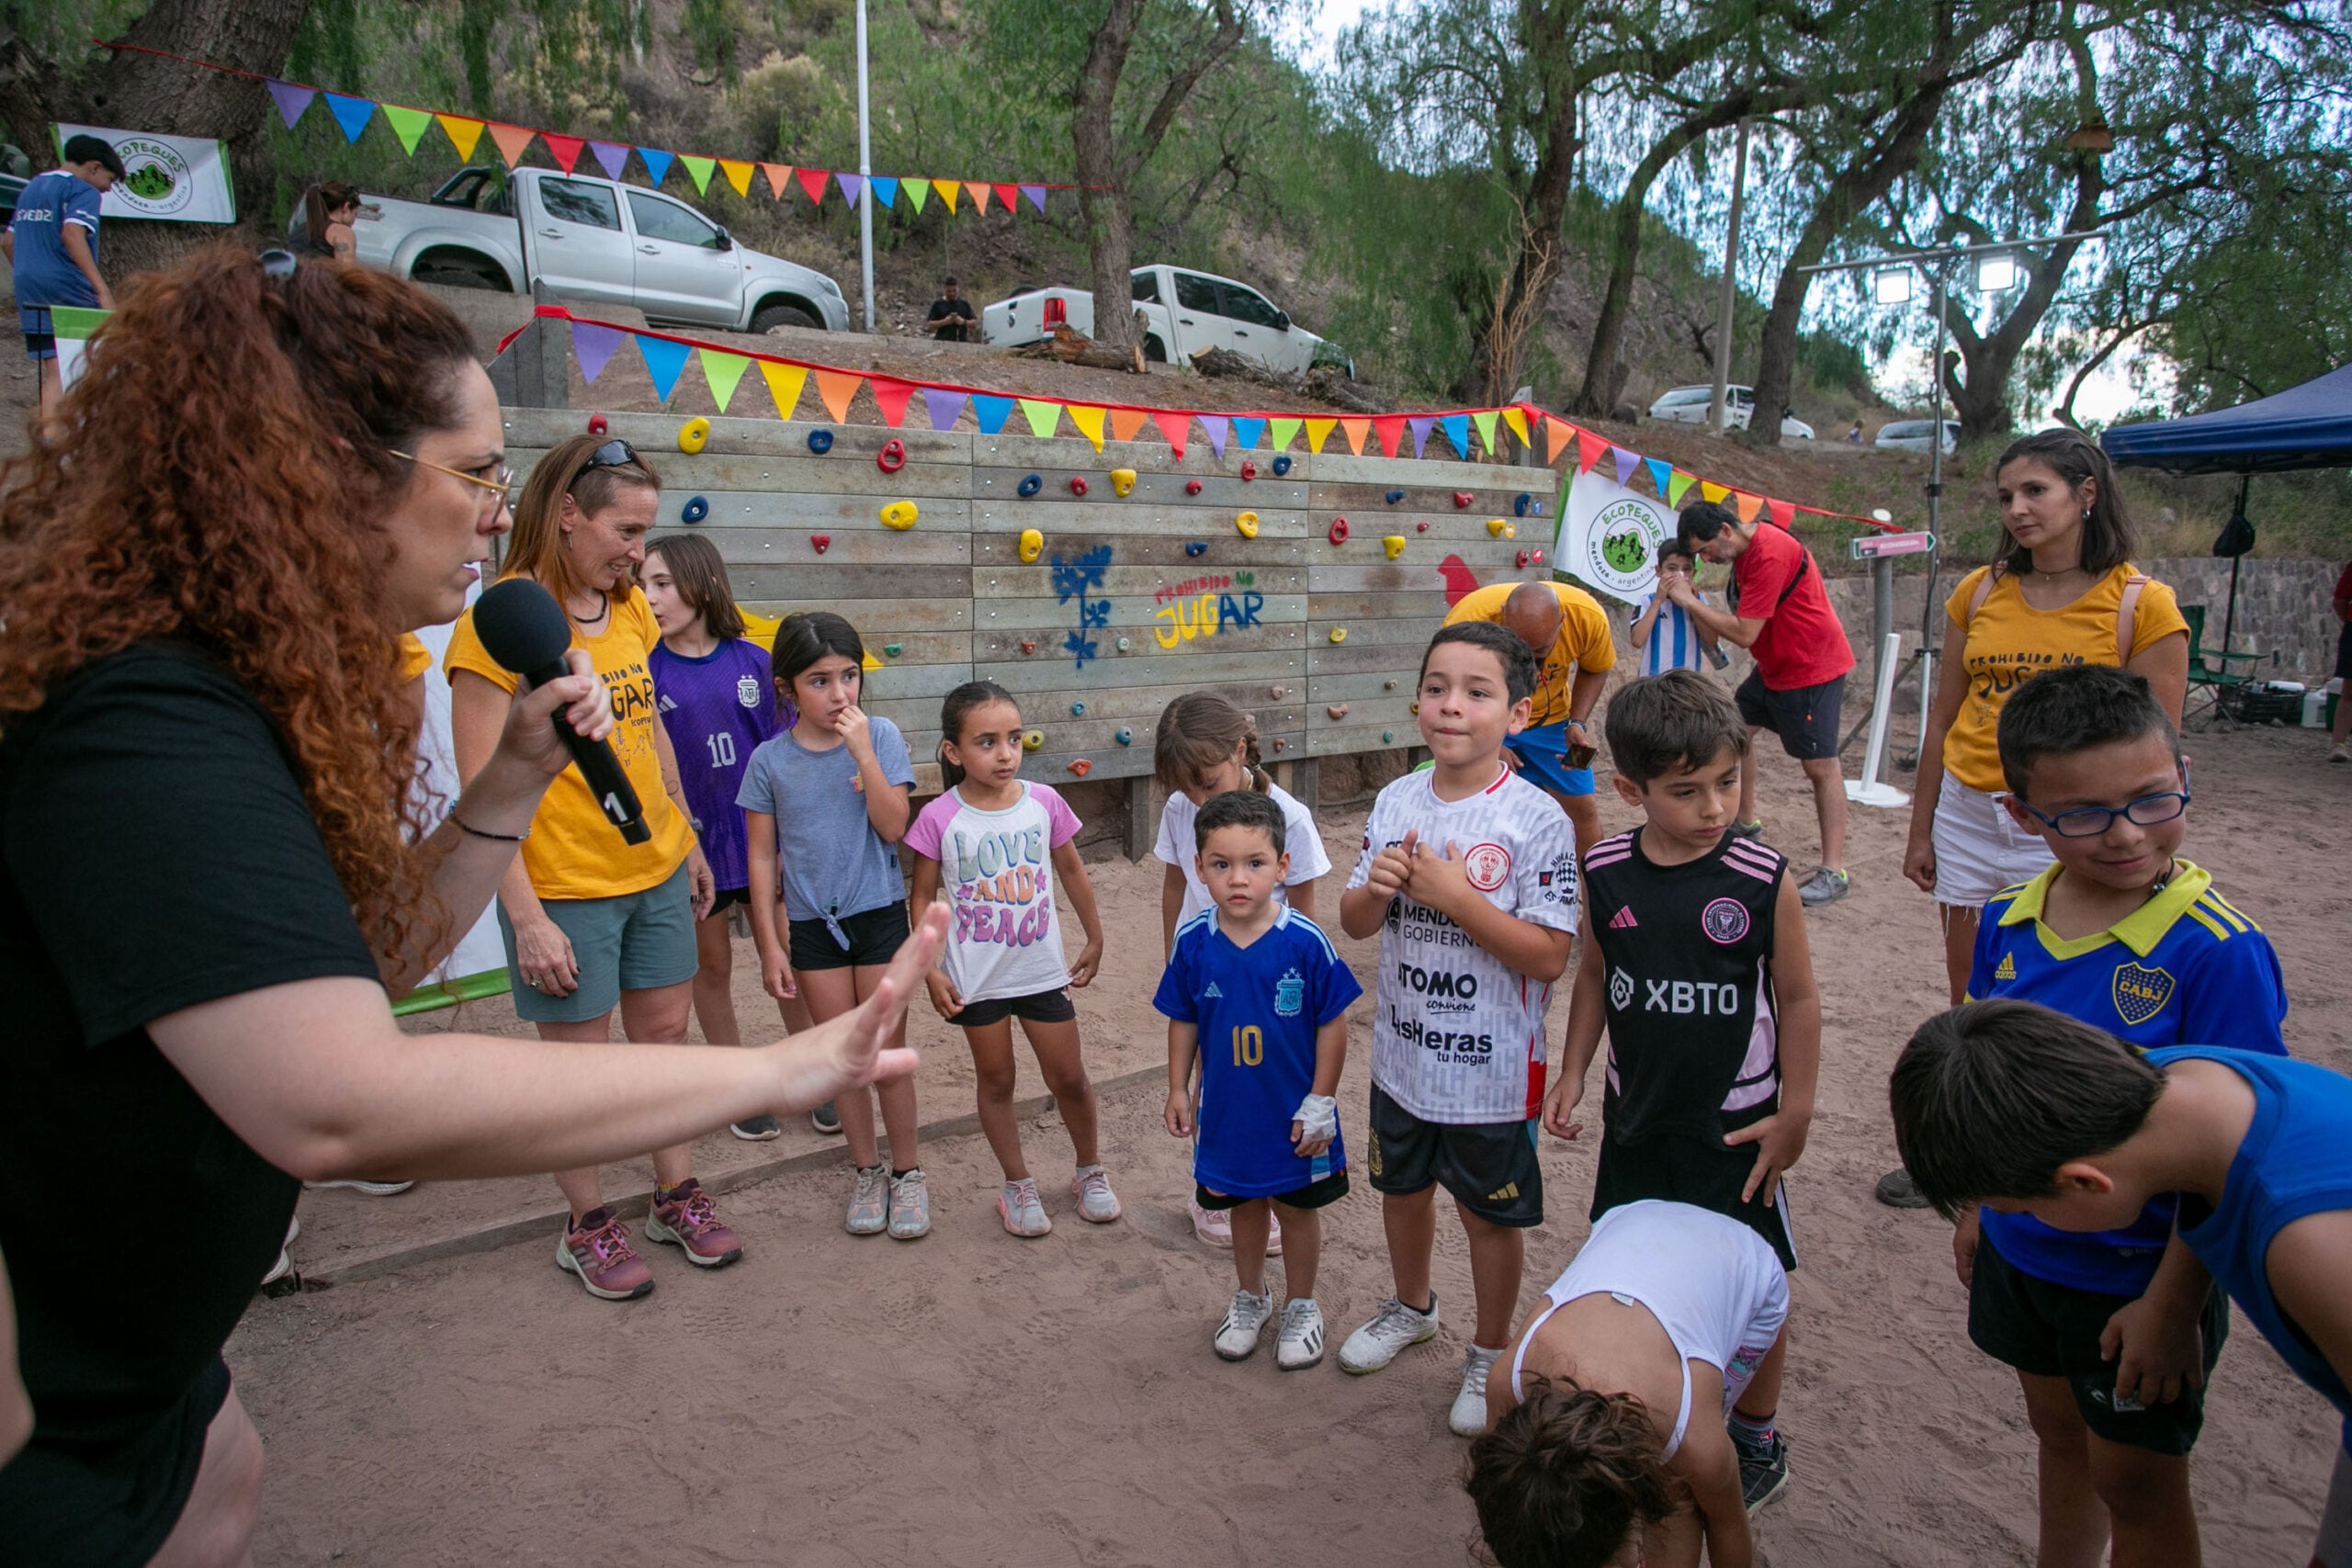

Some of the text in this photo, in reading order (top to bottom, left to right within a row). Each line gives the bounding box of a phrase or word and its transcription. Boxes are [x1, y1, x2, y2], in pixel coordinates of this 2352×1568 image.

[117, 141, 185, 173] COPEQUES
[1602, 503, 1664, 548] ECOPEQUES
[1590, 541, 1610, 578] mendoza
[1155, 570, 1254, 604] PROHIBIDO NO
[1155, 590, 1264, 649] JUGAR
[628, 662, 643, 674] NO
[1969, 652, 2085, 670] PROHIBIDO NO
[609, 678, 653, 722] GAR
[707, 731, 736, 768] 10
[604, 792, 628, 822] 1
[954, 821, 1043, 883] LOVE
[1551, 852, 1577, 868] HURAC
[972, 864, 1035, 906] AND
[956, 895, 1050, 947] PEACE
[1404, 904, 1460, 928] MEND
[1403, 924, 1482, 948] GOBIERN
[1426, 998, 1476, 1012] conviene
[1645, 978, 1738, 1015] XBTO
[2120, 980, 2165, 1001] CABJ
[1232, 1024, 1263, 1066] 10
[1437, 1052, 1492, 1066] tu hogar
